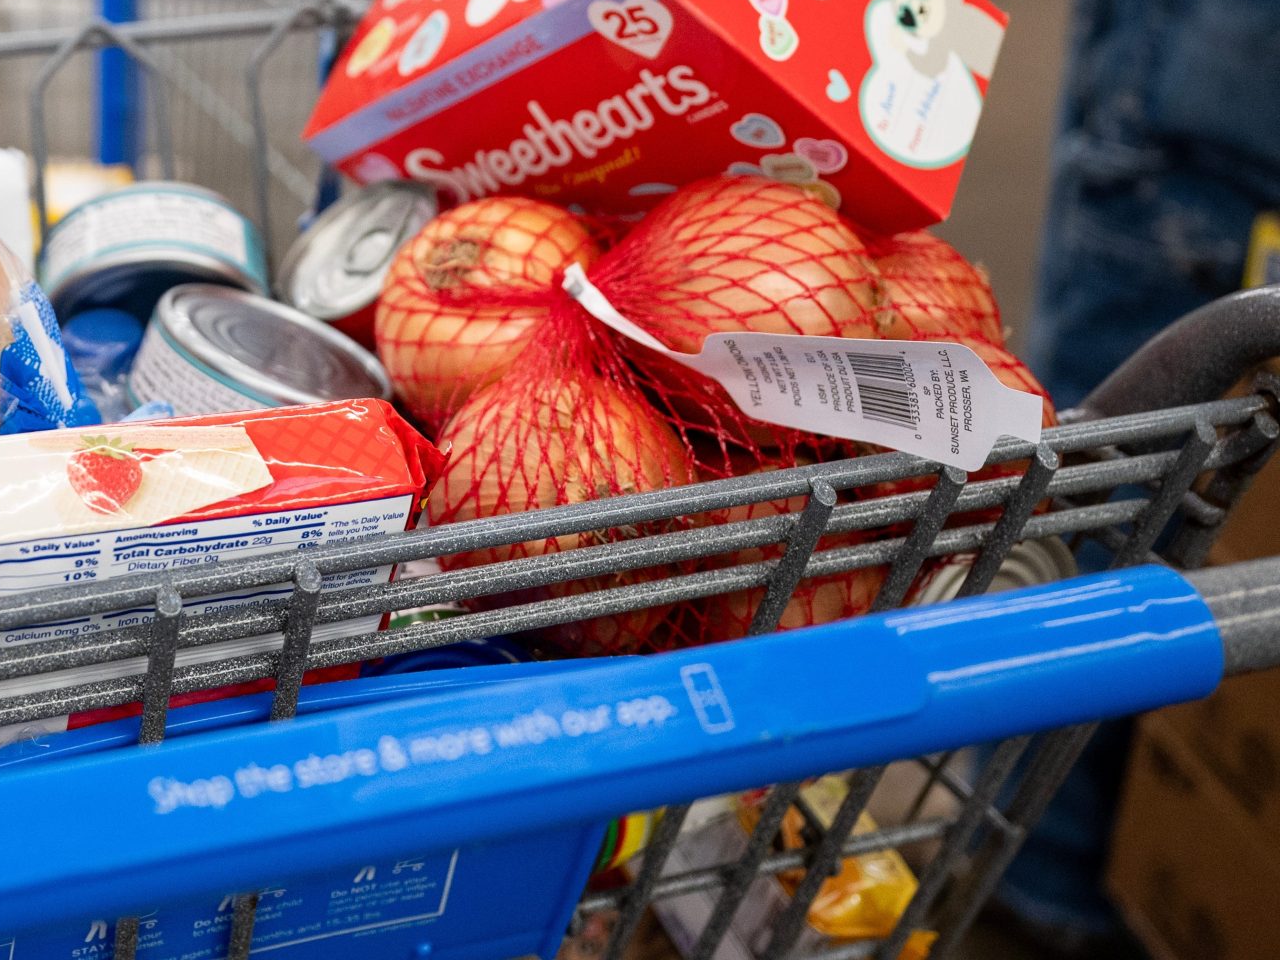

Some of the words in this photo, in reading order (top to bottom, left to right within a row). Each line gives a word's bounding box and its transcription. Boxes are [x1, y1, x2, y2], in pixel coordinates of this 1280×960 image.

[602, 6, 660, 40] 25
[404, 65, 710, 203] Sweethearts
[816, 350, 829, 362] USA
[831, 352, 844, 365] USA
[784, 367, 796, 380] NET
[822, 362, 833, 372] OF
[838, 366, 848, 376] DU
[901, 362, 917, 388] 60002
[929, 369, 940, 383] BY:
[958, 369, 969, 383] WA
[743, 365, 762, 407] YELLOW
[776, 380, 788, 395] NET
[790, 381, 802, 407] POIDS
[825, 373, 842, 412] PRODUCE
[923, 385, 931, 396] SP
[944, 369, 958, 415] PRODUCE,
[840, 376, 856, 413] PRODUIT
[932, 384, 945, 420] PACKED
[908, 392, 921, 422] 33383
[960, 385, 973, 432] PROSSER,
[950, 416, 960, 455] SUNSET
[360, 515, 380, 524] Daily
[382, 512, 404, 520] Value
[115, 527, 198, 544] Amount/serving
[252, 519, 262, 527] %
[265, 515, 292, 527] Daily
[328, 528, 344, 537] tells
[346, 528, 360, 537] you
[362, 524, 379, 532] how
[20, 547, 30, 555] %
[32, 542, 61, 553] Daily
[113, 549, 151, 562] Total
[153, 538, 249, 558] Carbohydrate
[252, 535, 273, 546] 22g
[301, 528, 323, 539] 8%
[74, 557, 99, 568] 9%
[127, 557, 170, 572] Dietary
[172, 555, 202, 567] Fiber
[204, 554, 219, 564] 0g
[63, 570, 97, 582] 10%
[348, 569, 377, 580] general
[5, 630, 52, 643] Calcium
[54, 626, 79, 639] 0mg
[82, 622, 101, 633] 0%
[118, 616, 139, 627] Iron
[148, 775, 235, 814] Shop
[234, 762, 293, 798] the
[293, 752, 377, 788] store
[378, 734, 408, 772] &
[410, 726, 491, 763] more
[492, 709, 560, 747] with
[561, 705, 609, 737] our
[331, 890, 348, 899] Do
[351, 884, 378, 894] NOT
[194, 920, 212, 929] Do
[71, 942, 107, 958] STAY
